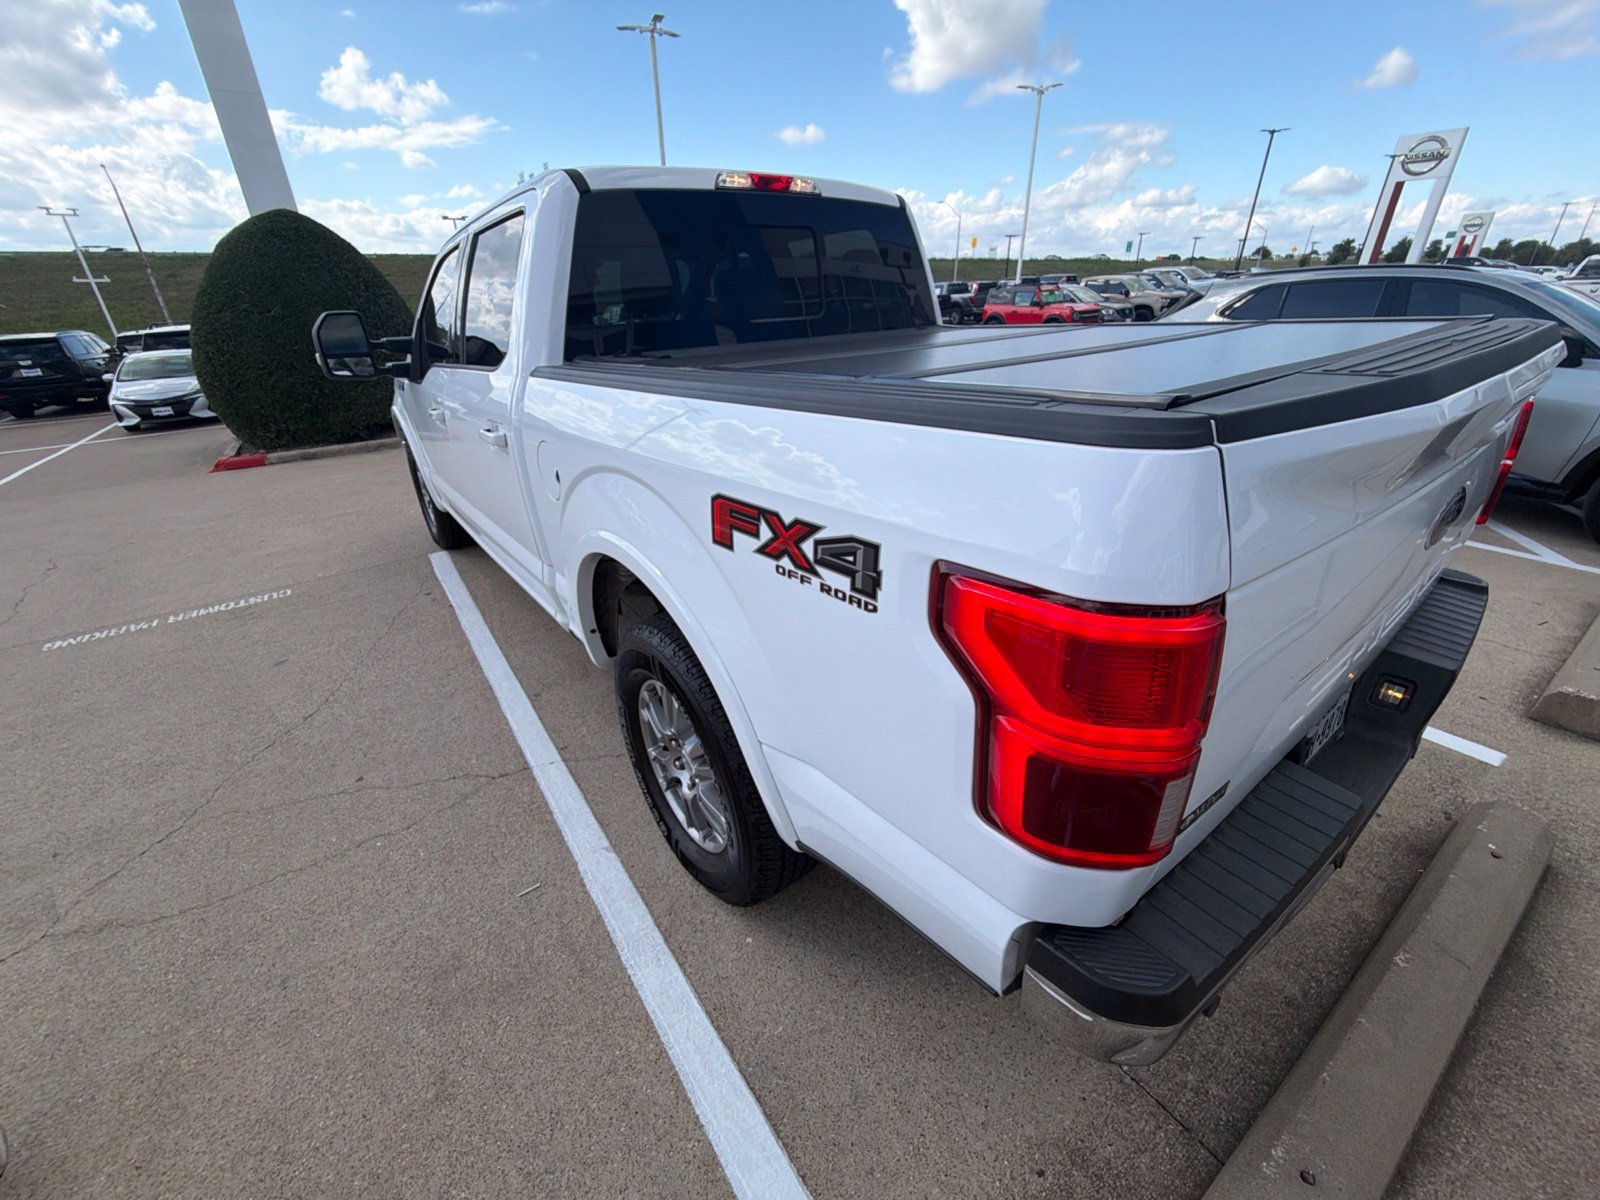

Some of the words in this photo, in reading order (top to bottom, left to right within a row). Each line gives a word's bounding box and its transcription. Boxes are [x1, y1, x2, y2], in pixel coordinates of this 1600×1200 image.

[711, 492, 883, 603] FX4
[167, 588, 293, 624] CUSTOMER
[775, 564, 813, 586] OFF
[819, 581, 878, 614] ROAD
[41, 619, 160, 652] PARKING
